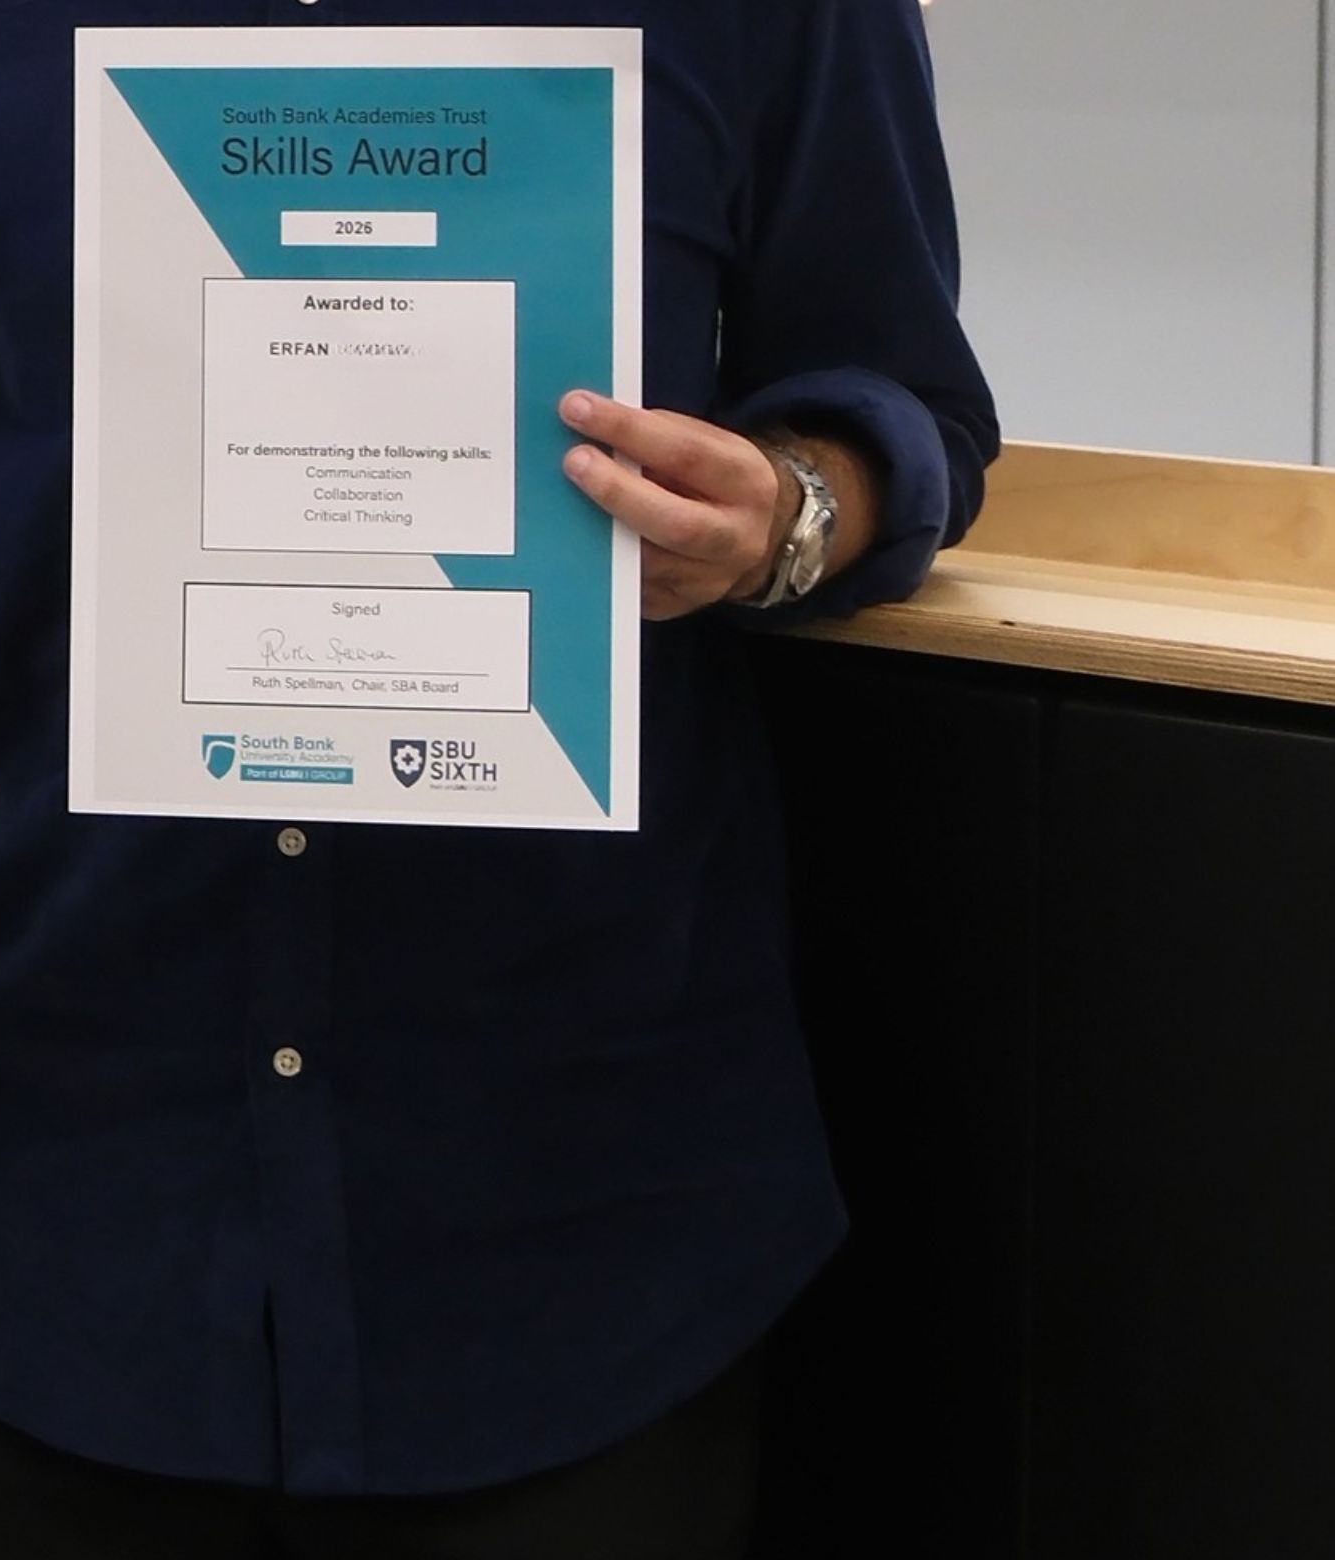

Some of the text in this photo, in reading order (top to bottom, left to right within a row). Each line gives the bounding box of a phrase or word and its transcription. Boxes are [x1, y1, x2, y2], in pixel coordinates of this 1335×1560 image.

[222, 107, 487, 125] South Bank Academies Trust
[221, 136, 487, 176] Skills Award
[335, 221, 373, 234] 2026
[303, 295, 414, 311] Awarded to:
[269, 342, 329, 356] ERFAN
[227, 444, 491, 462] For demonstrating the following skills:
[306, 466, 412, 479] Communication
[313, 488, 403, 501] Collaboration
[304, 509, 413, 526] Critical Thinking
[332, 602, 380, 618] Signed
[253, 676, 280, 688] Ruth
[391, 680, 417, 692] SBA
[422, 681, 459, 693] Board
[241, 734, 334, 751] South Bank
[431, 740, 475, 759] SBU
[430, 762, 497, 781] SIXTH
